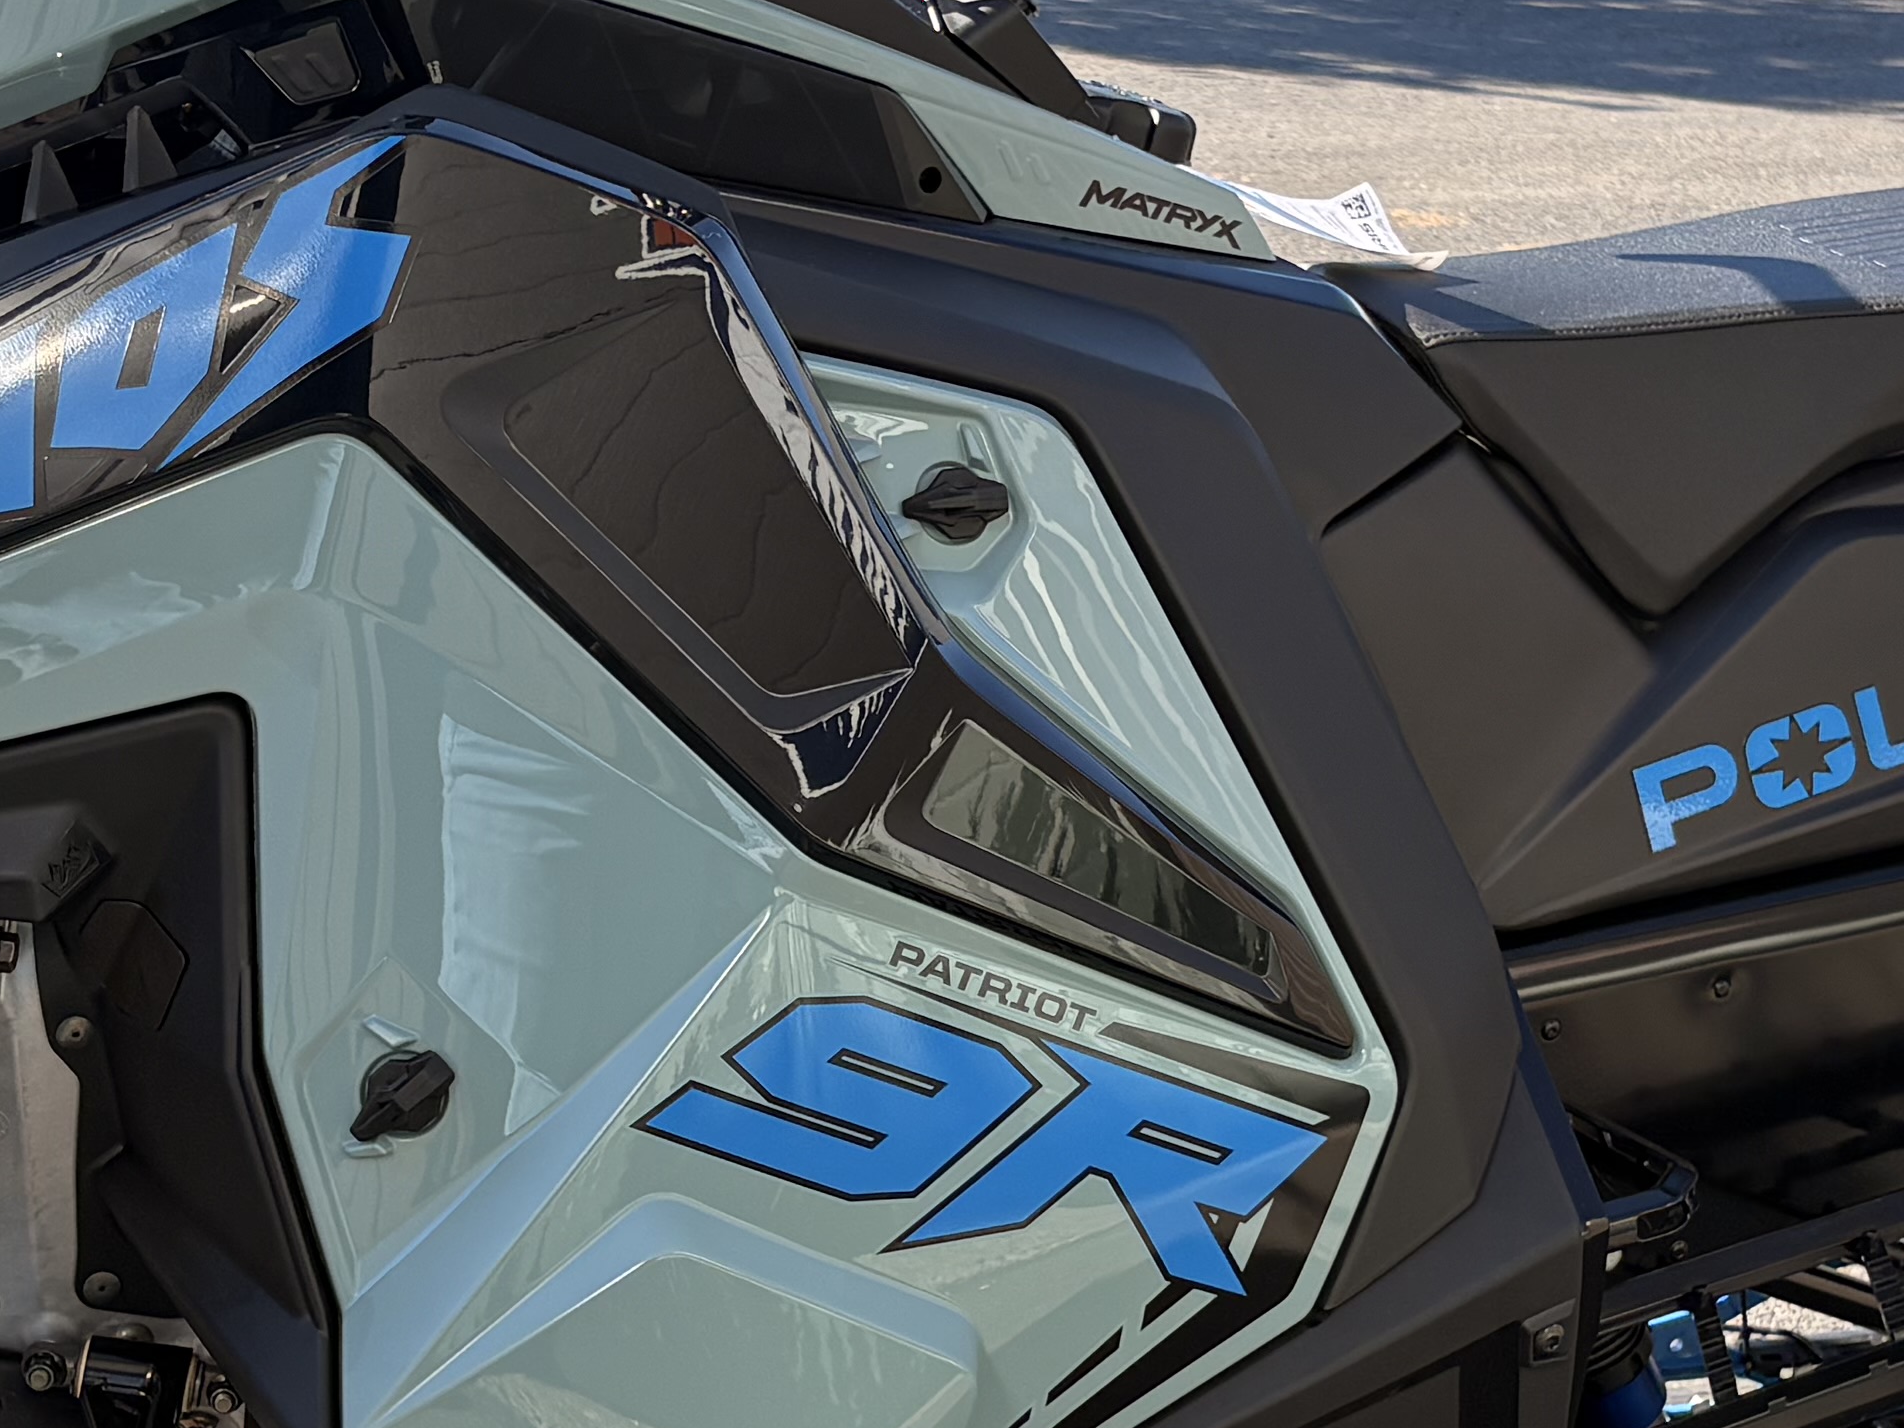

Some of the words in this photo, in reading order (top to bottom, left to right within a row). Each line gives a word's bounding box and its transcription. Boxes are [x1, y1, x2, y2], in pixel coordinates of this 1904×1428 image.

[1078, 179, 1243, 251] MATRYX
[889, 940, 1100, 1035] PATRIOT
[629, 994, 1331, 1299] 9R
